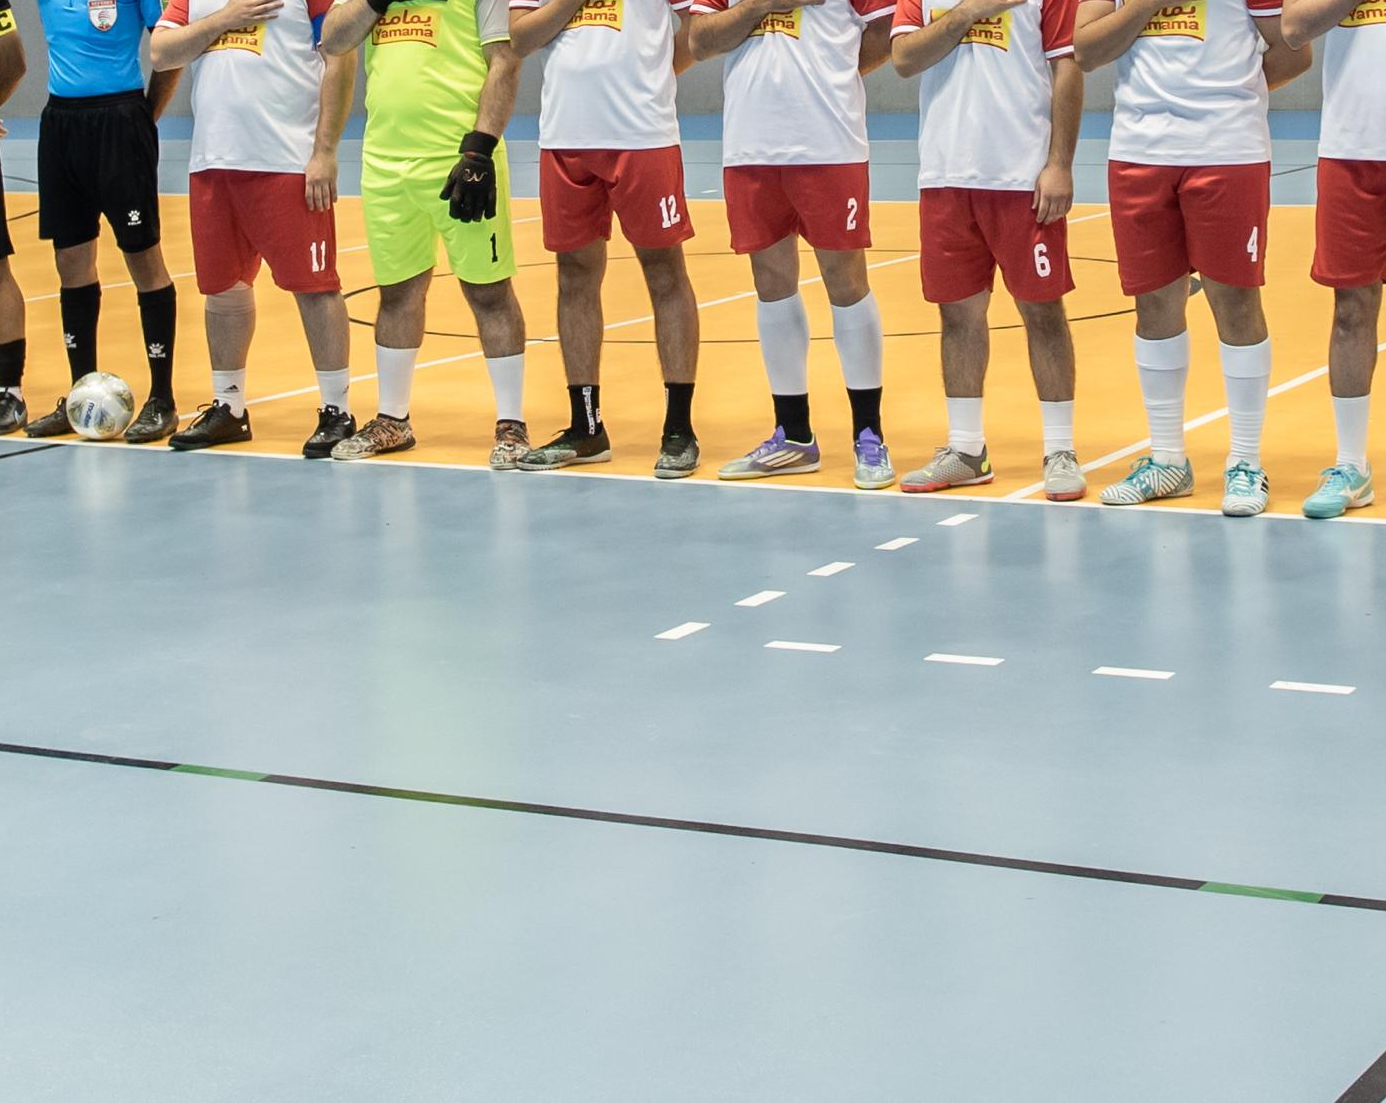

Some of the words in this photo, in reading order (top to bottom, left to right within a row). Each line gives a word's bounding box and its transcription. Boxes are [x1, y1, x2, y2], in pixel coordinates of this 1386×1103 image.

[659, 194, 681, 229] 12
[846, 197, 858, 231] 2
[310, 240, 326, 273] 11
[489, 232, 498, 263] 1
[1033, 242, 1051, 278] 6
[1246, 226, 1258, 263] 4
